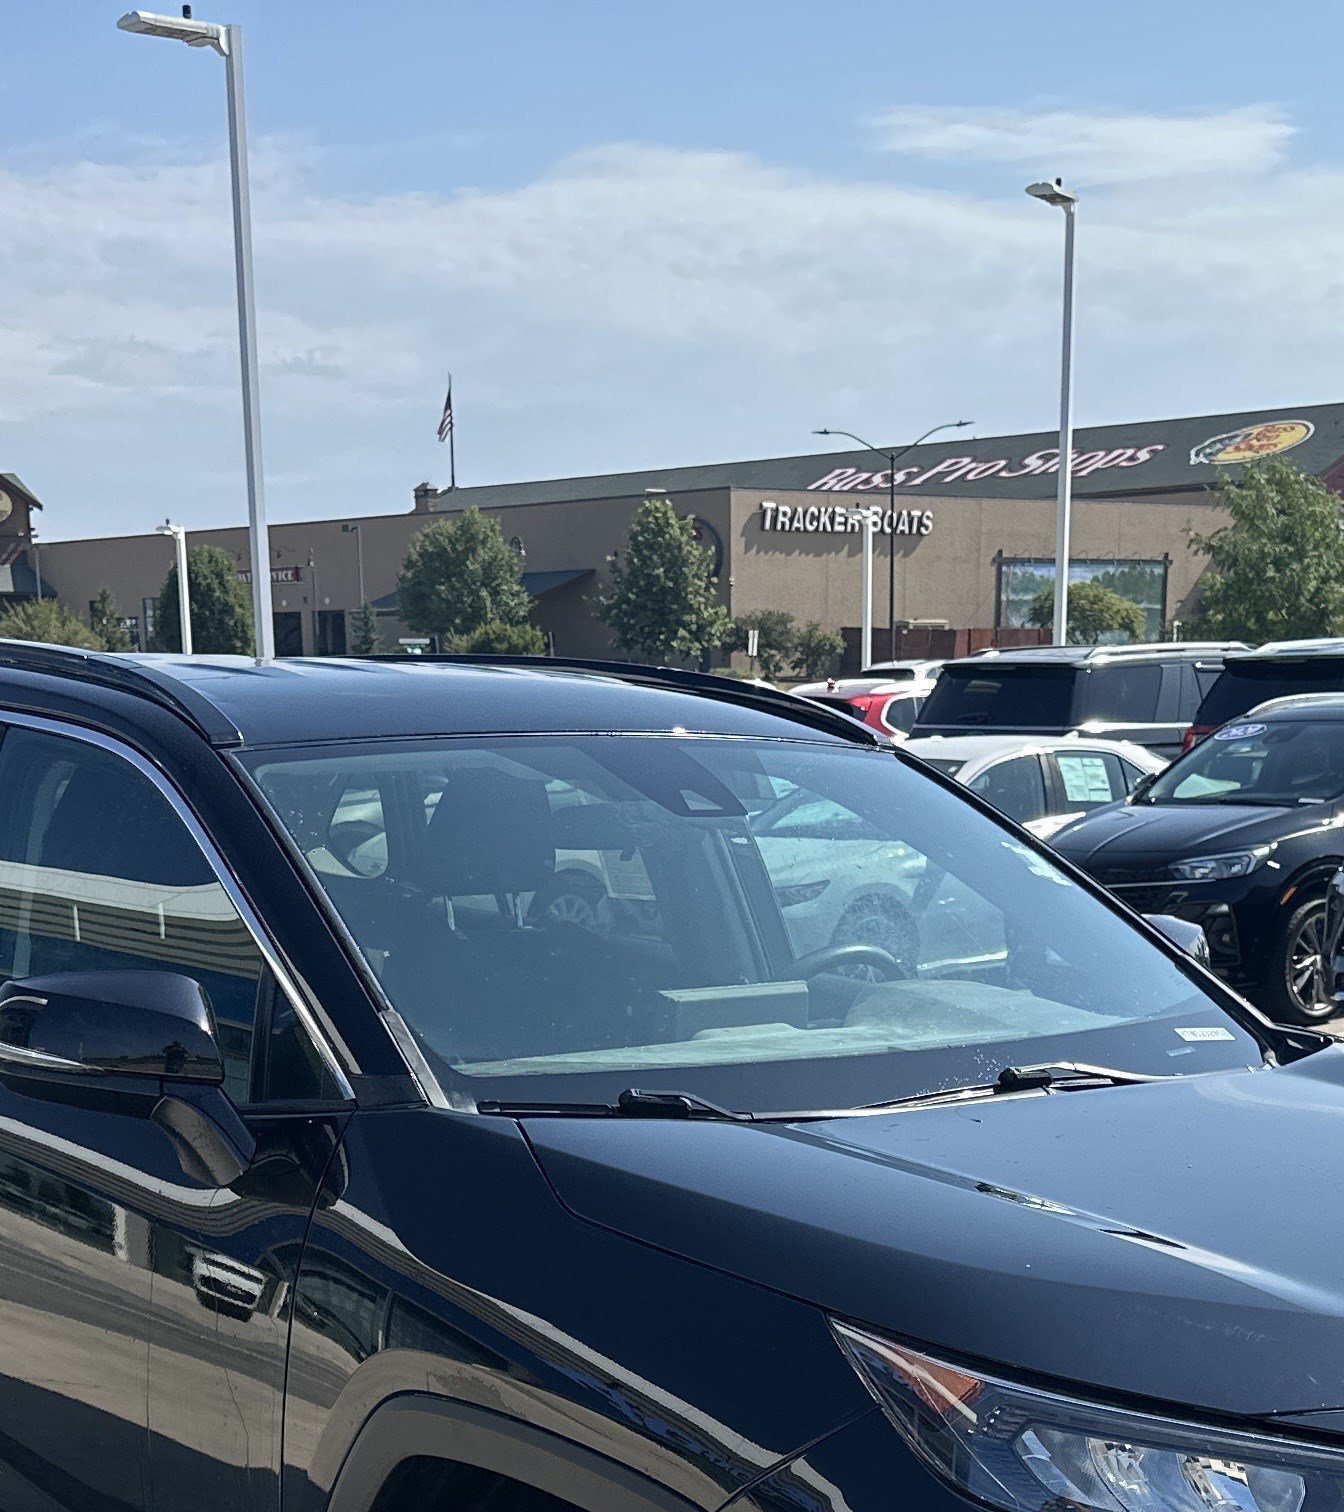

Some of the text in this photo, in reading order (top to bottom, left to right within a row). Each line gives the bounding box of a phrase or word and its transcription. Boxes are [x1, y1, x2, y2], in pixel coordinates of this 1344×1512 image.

[805, 444, 1167, 491] Bass Pro Shops
[867, 505, 934, 535] BOATS
